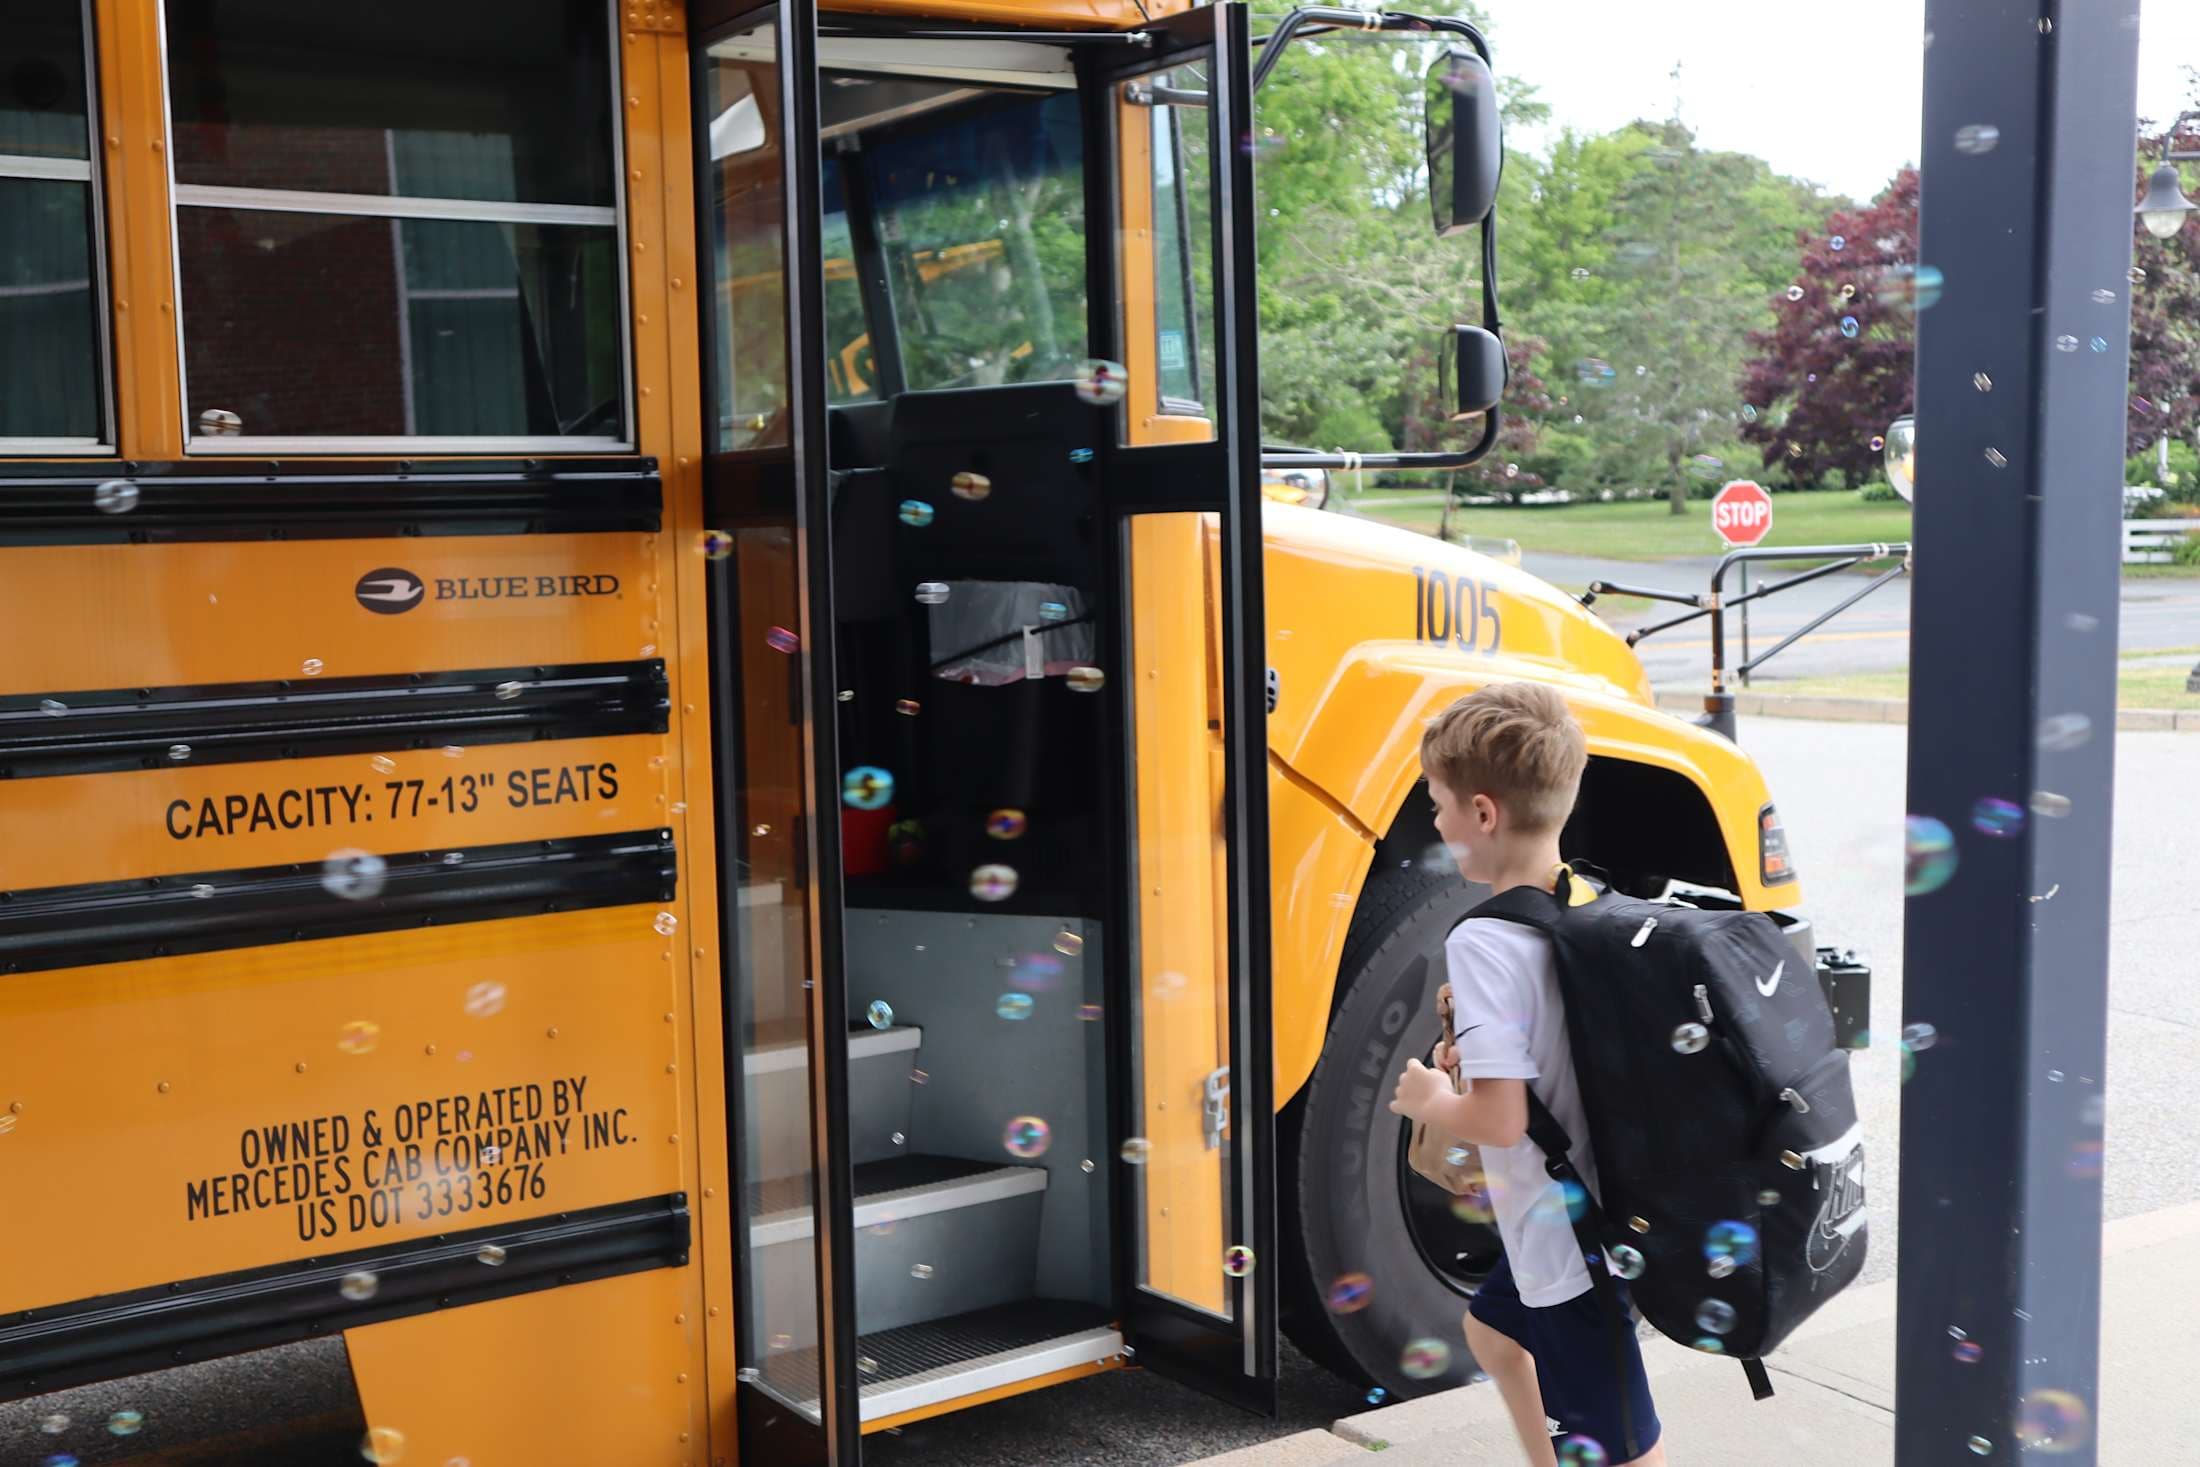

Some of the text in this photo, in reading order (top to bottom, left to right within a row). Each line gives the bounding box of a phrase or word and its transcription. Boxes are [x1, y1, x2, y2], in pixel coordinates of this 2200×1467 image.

[1717, 501, 1768, 528] STOP
[434, 574, 620, 600] BLUE BIRD
[1411, 565, 1501, 657] 1005
[165, 762, 619, 840] CAPACITY: 77-13" SEATS
[240, 1076, 587, 1169] OWNED & OPERATED BY
[187, 1108, 637, 1221] MERCEDES CAB COMPANY INC.
[297, 1162, 546, 1242] US DOT 3333676
